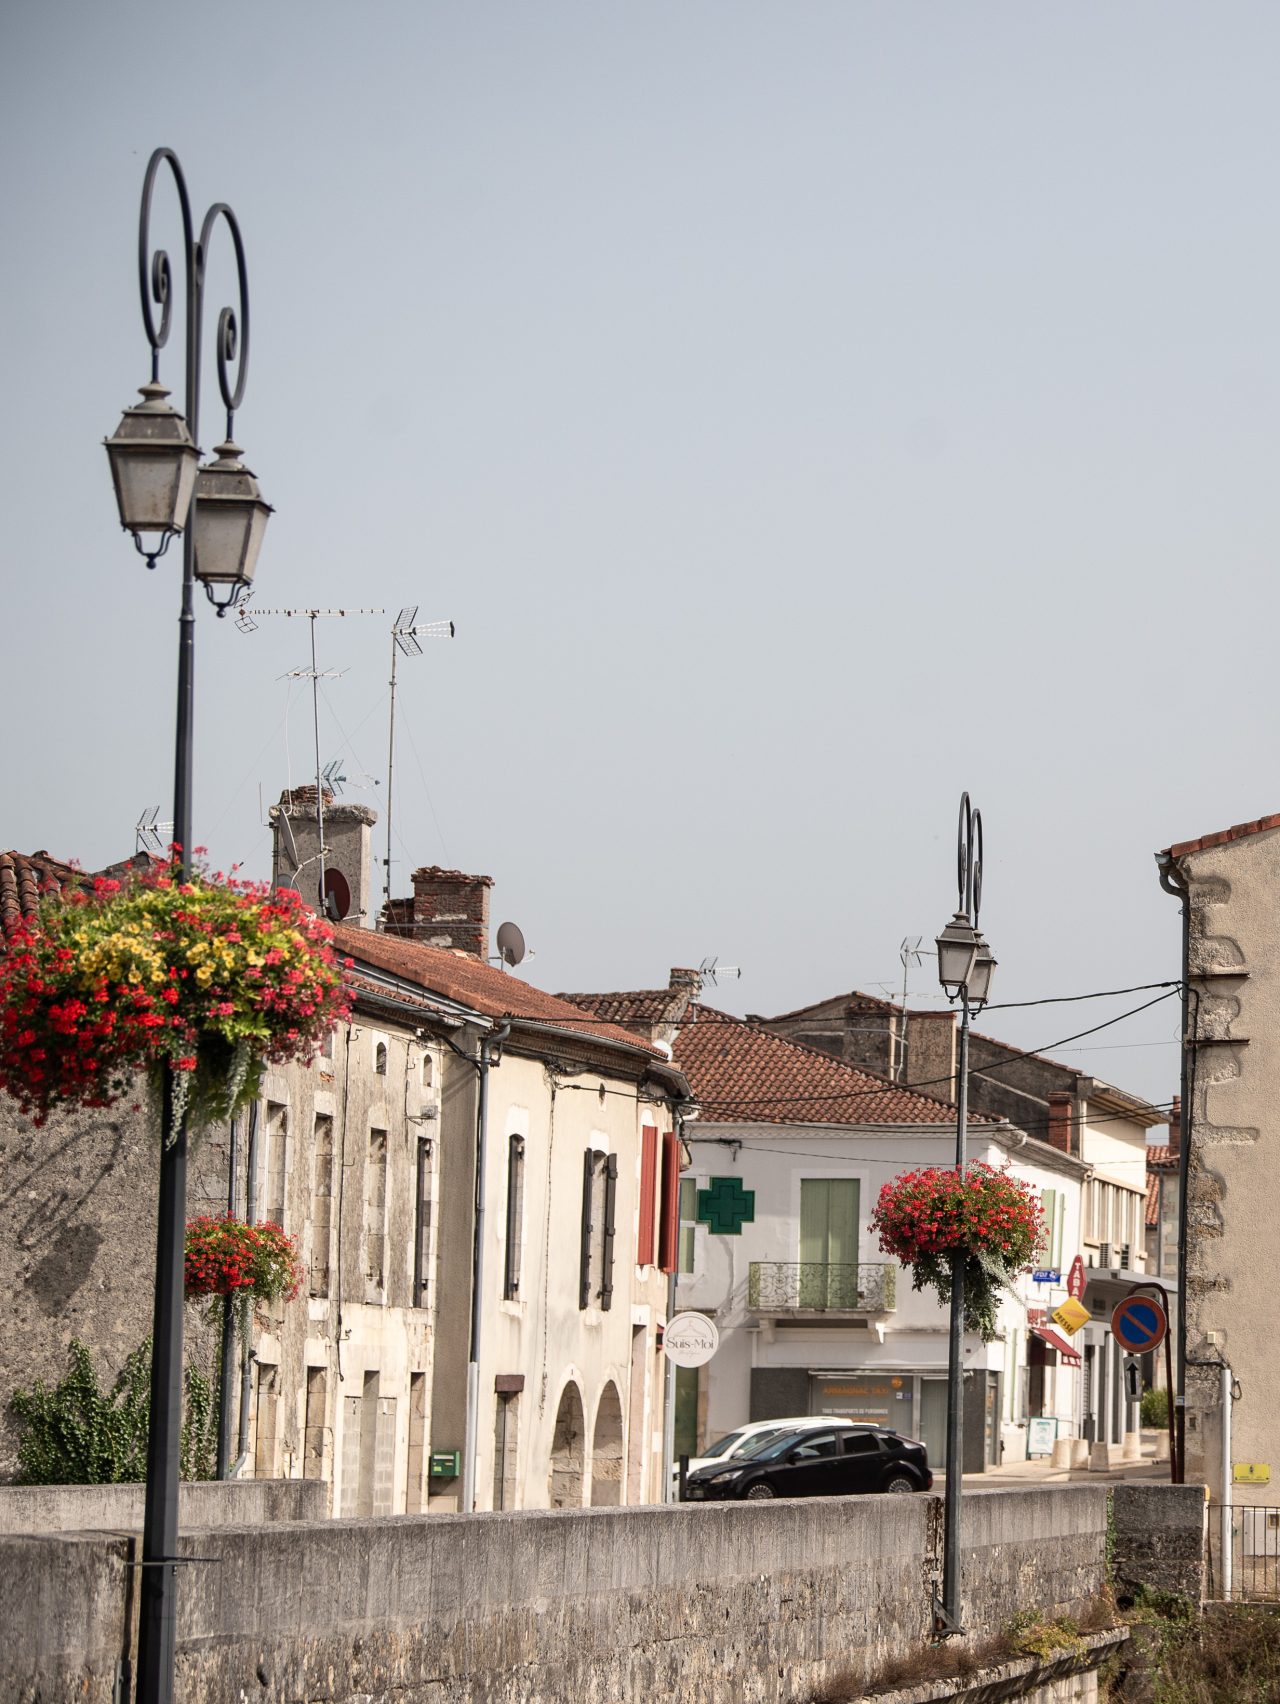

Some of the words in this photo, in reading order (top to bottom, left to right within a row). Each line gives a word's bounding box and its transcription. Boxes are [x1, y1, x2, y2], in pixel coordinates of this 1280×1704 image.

[1071, 1263, 1081, 1299] TABA
[1055, 1312, 1074, 1332] PRESSE
[665, 1336, 715, 1350] Suis-Moi
